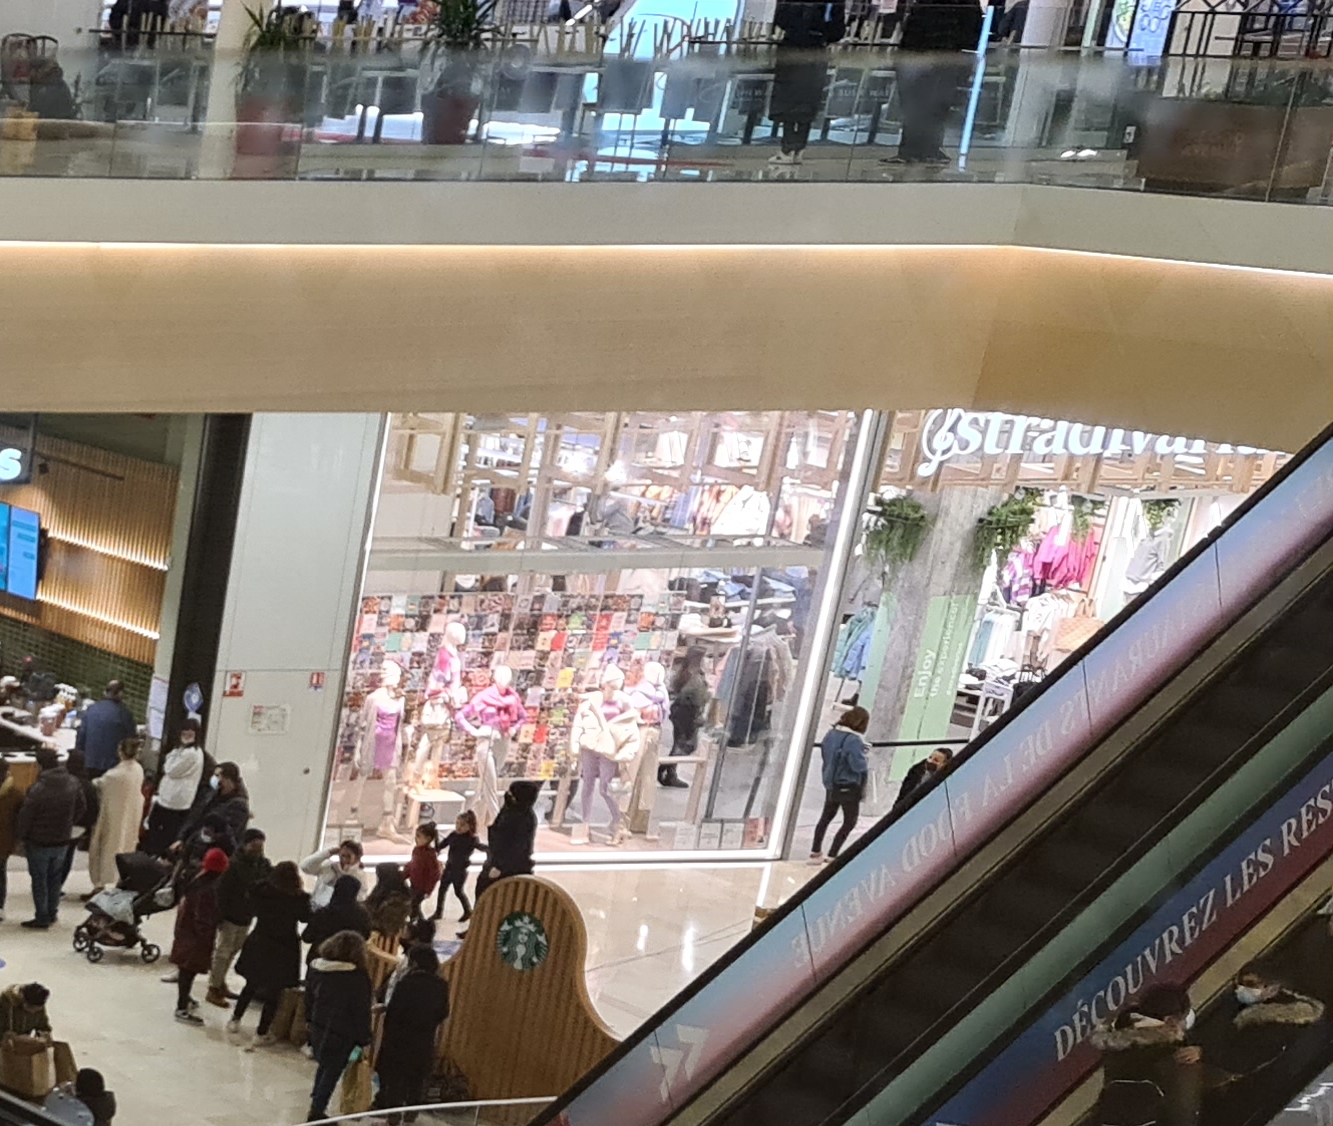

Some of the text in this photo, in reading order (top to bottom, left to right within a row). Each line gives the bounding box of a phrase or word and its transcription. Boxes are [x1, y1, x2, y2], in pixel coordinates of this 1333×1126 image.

[914, 649, 936, 698] Enjoy
[1053, 779, 1333, 1062] DÉCOUVREZ LES RES
